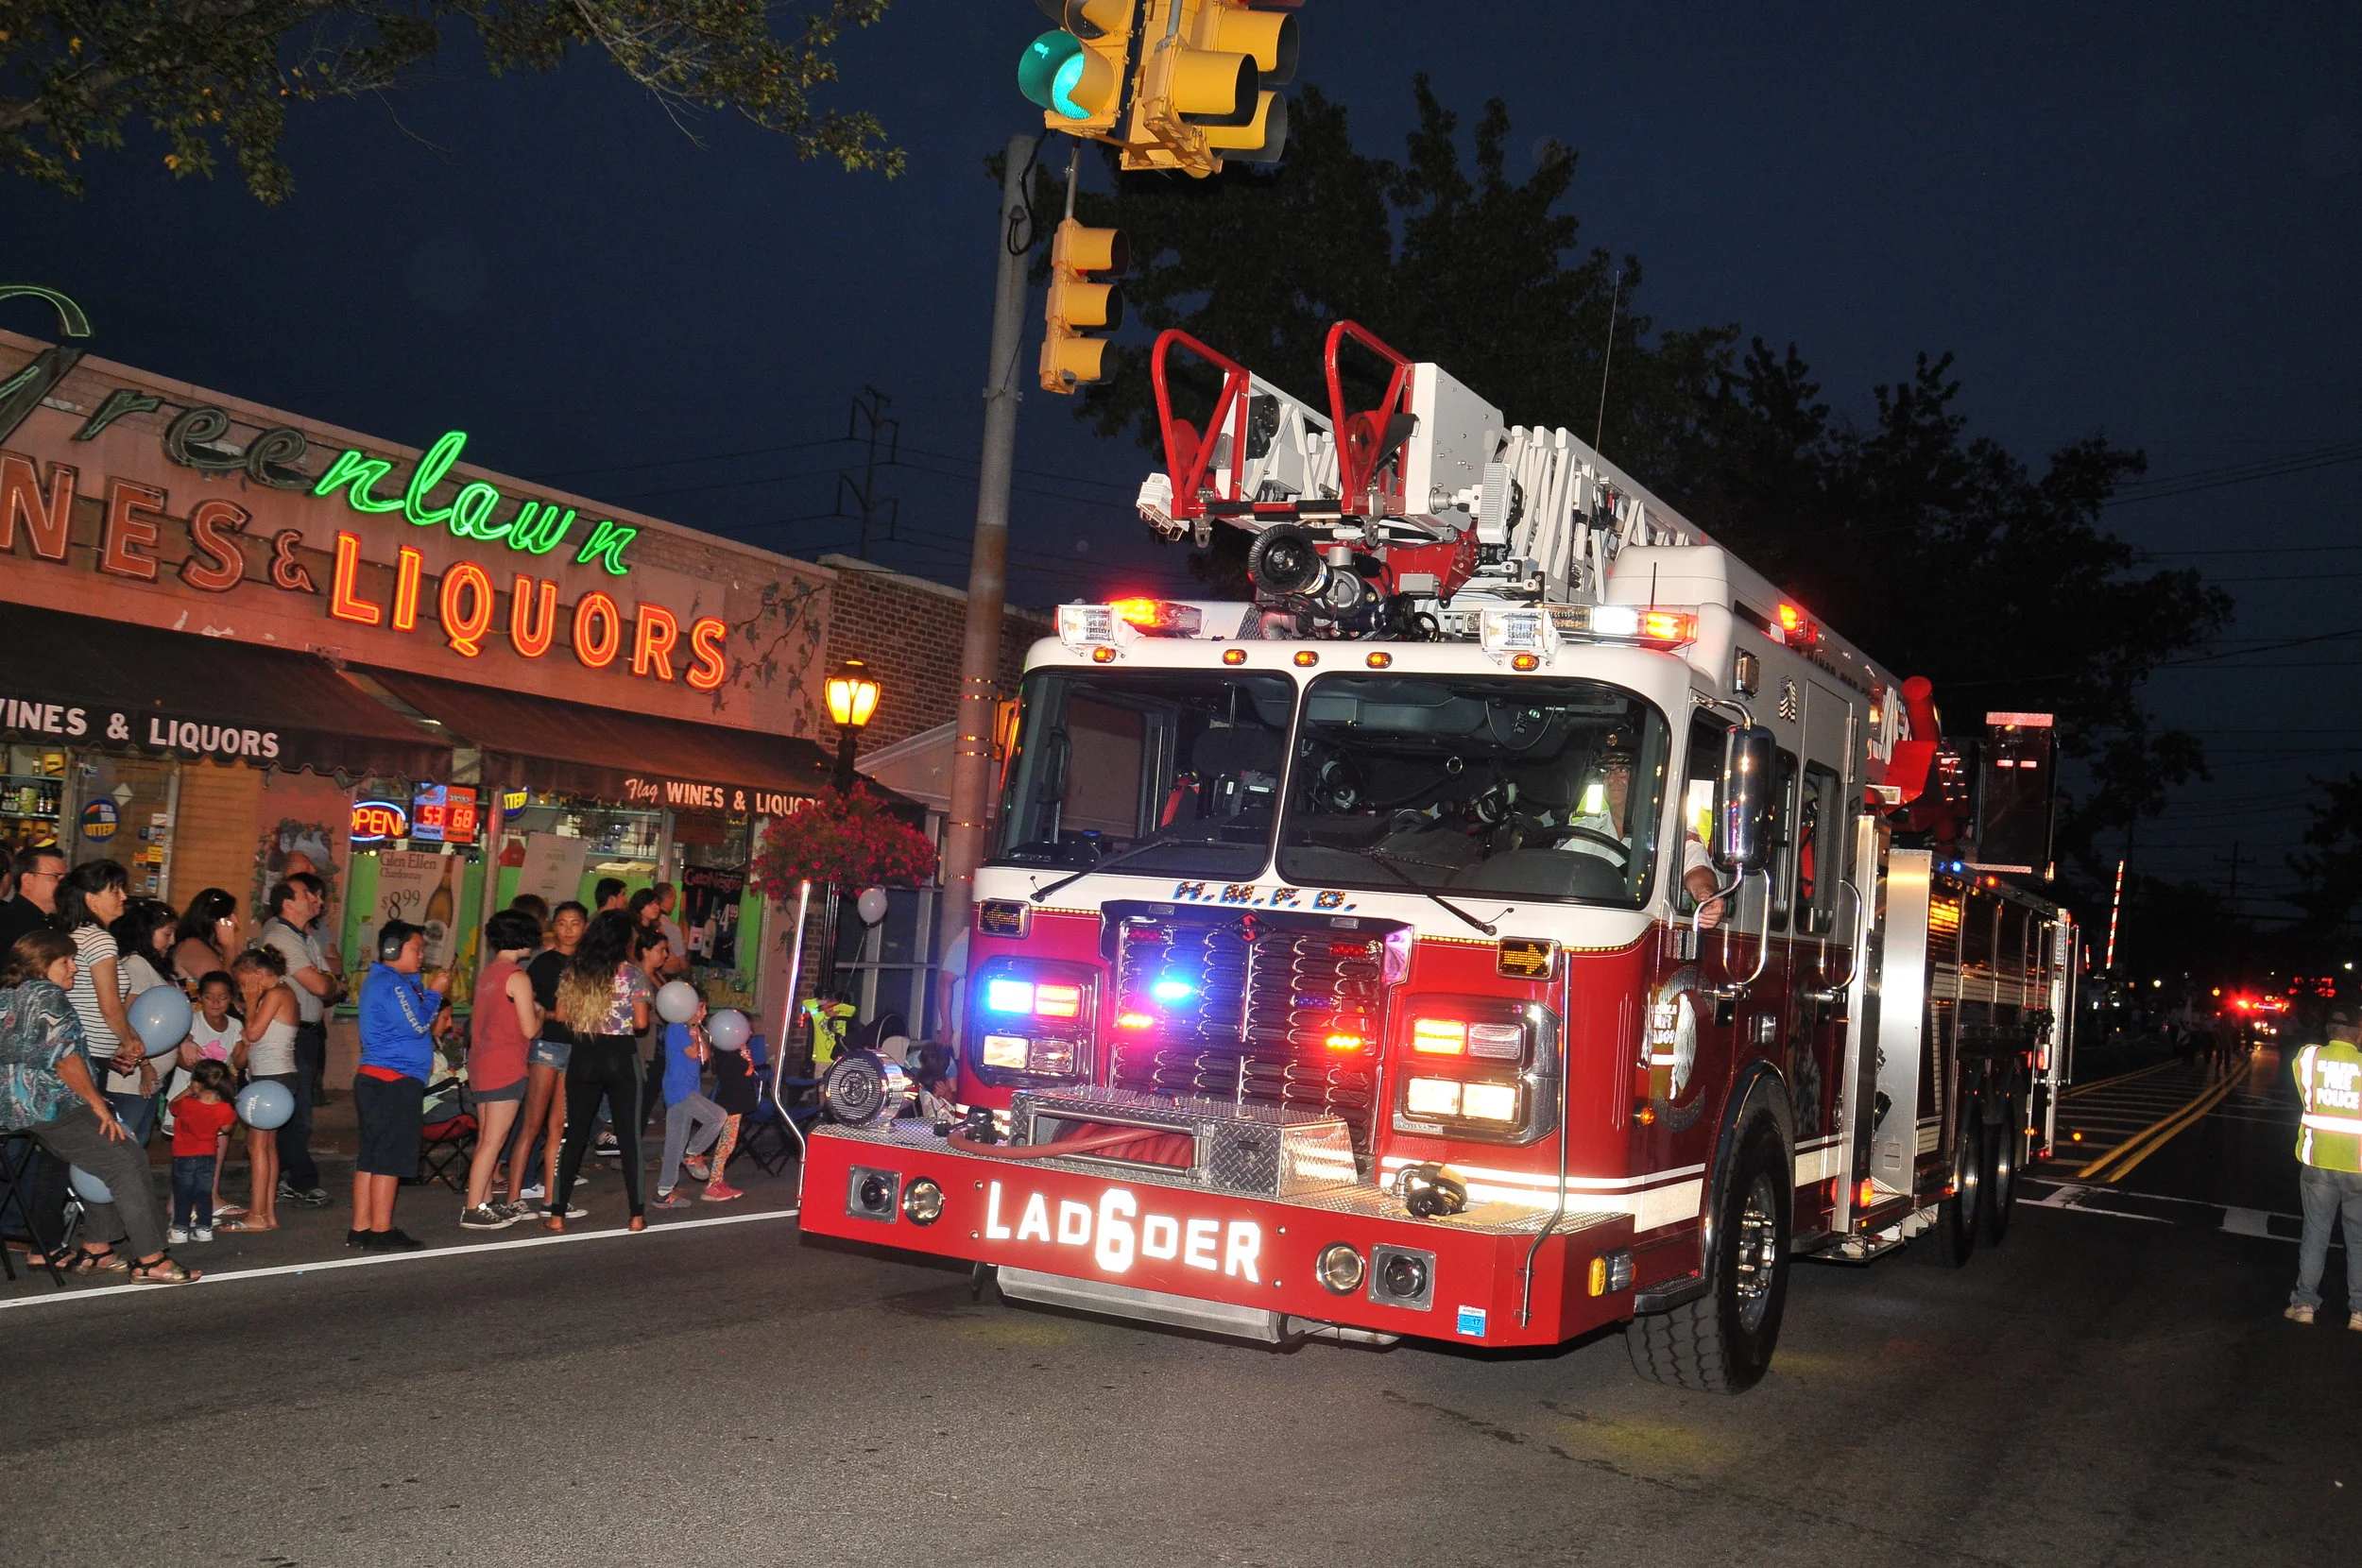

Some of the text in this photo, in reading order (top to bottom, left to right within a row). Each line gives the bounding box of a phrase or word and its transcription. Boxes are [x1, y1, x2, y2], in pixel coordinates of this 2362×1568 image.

[270, 529, 318, 594] &
[330, 531, 728, 690] LIQUORS
[106, 712, 129, 741] &
[149, 718, 280, 758] LIQUORS
[625, 778, 659, 803] Flag
[666, 781, 725, 809] WINES
[733, 790, 746, 811] &
[422, 806, 443, 827] 53
[453, 809, 474, 828] 68
[381, 852, 436, 869] Glen Ellen
[394, 985, 419, 1028] UNDER
[2317, 1088, 2360, 1110] POLICE
